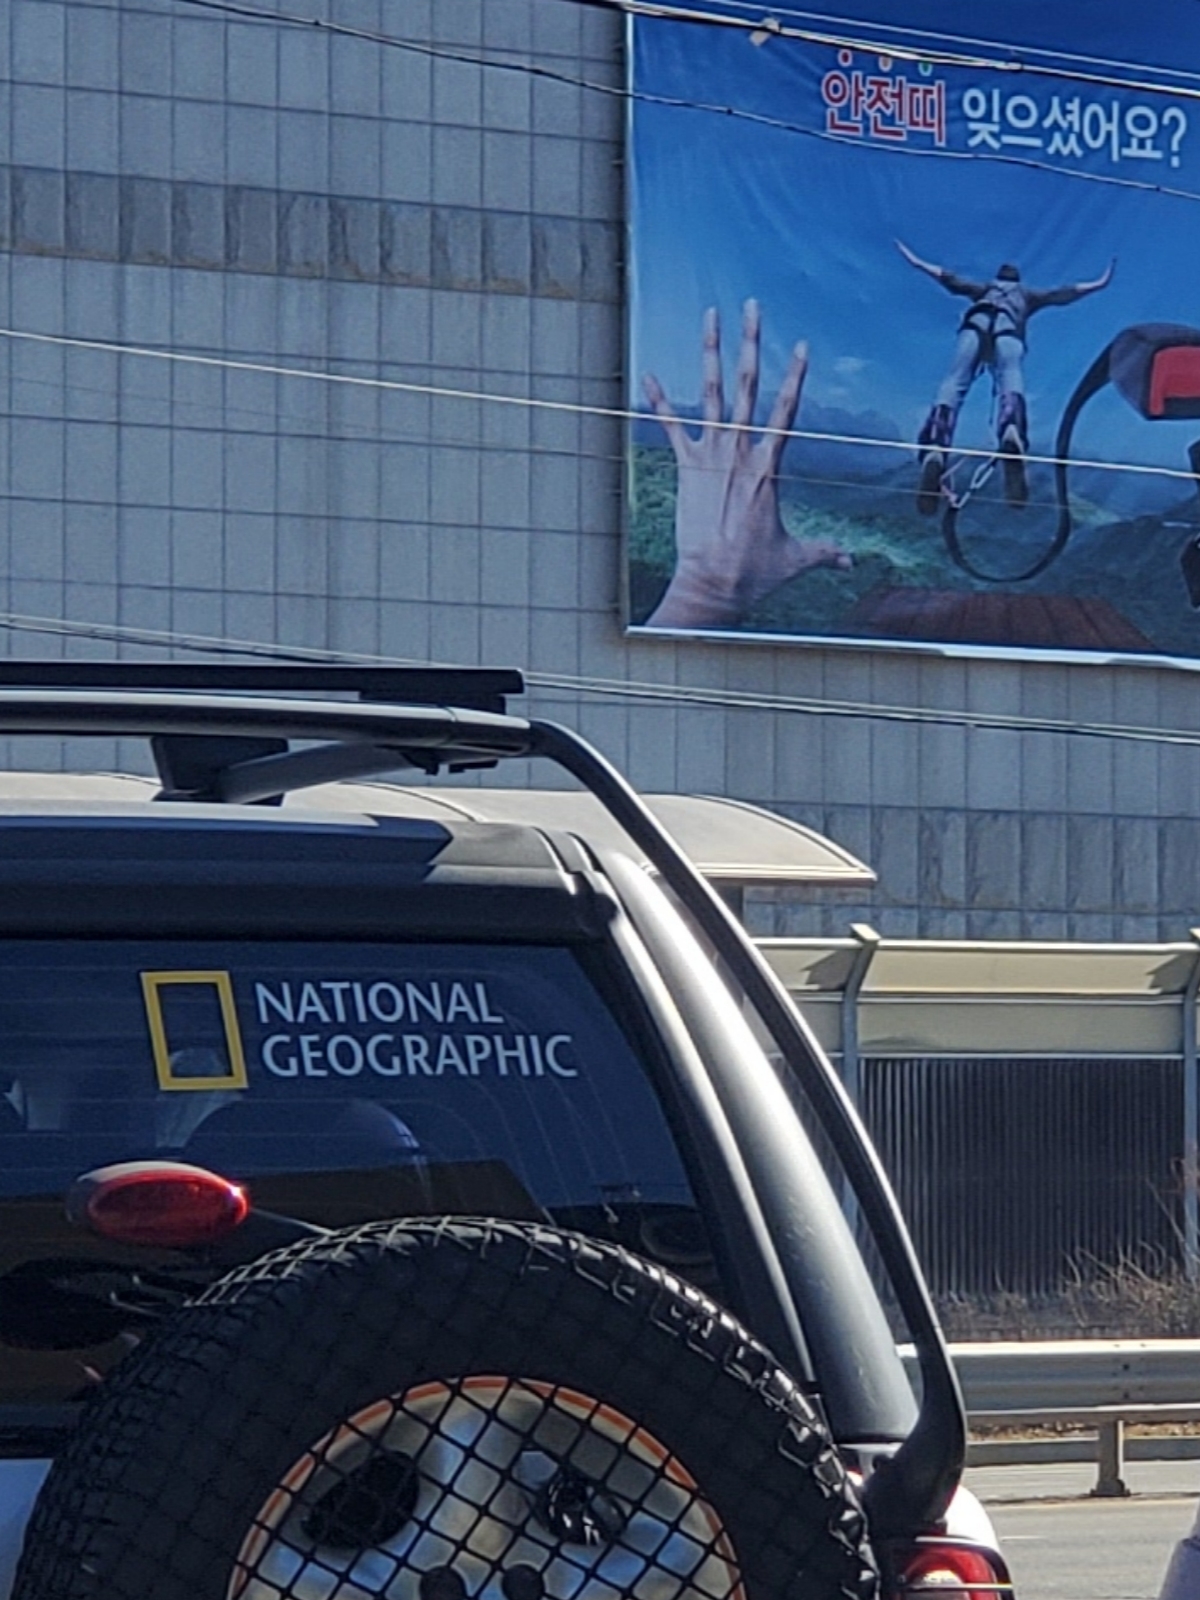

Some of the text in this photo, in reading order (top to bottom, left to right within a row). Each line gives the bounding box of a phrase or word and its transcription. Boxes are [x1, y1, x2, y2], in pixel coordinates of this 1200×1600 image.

[822, 70, 1187, 168] 안전띠 잊으셨어요?
[255, 981, 504, 1024] NATIONAL
[262, 1034, 577, 1078] GEOGRAPHIC
